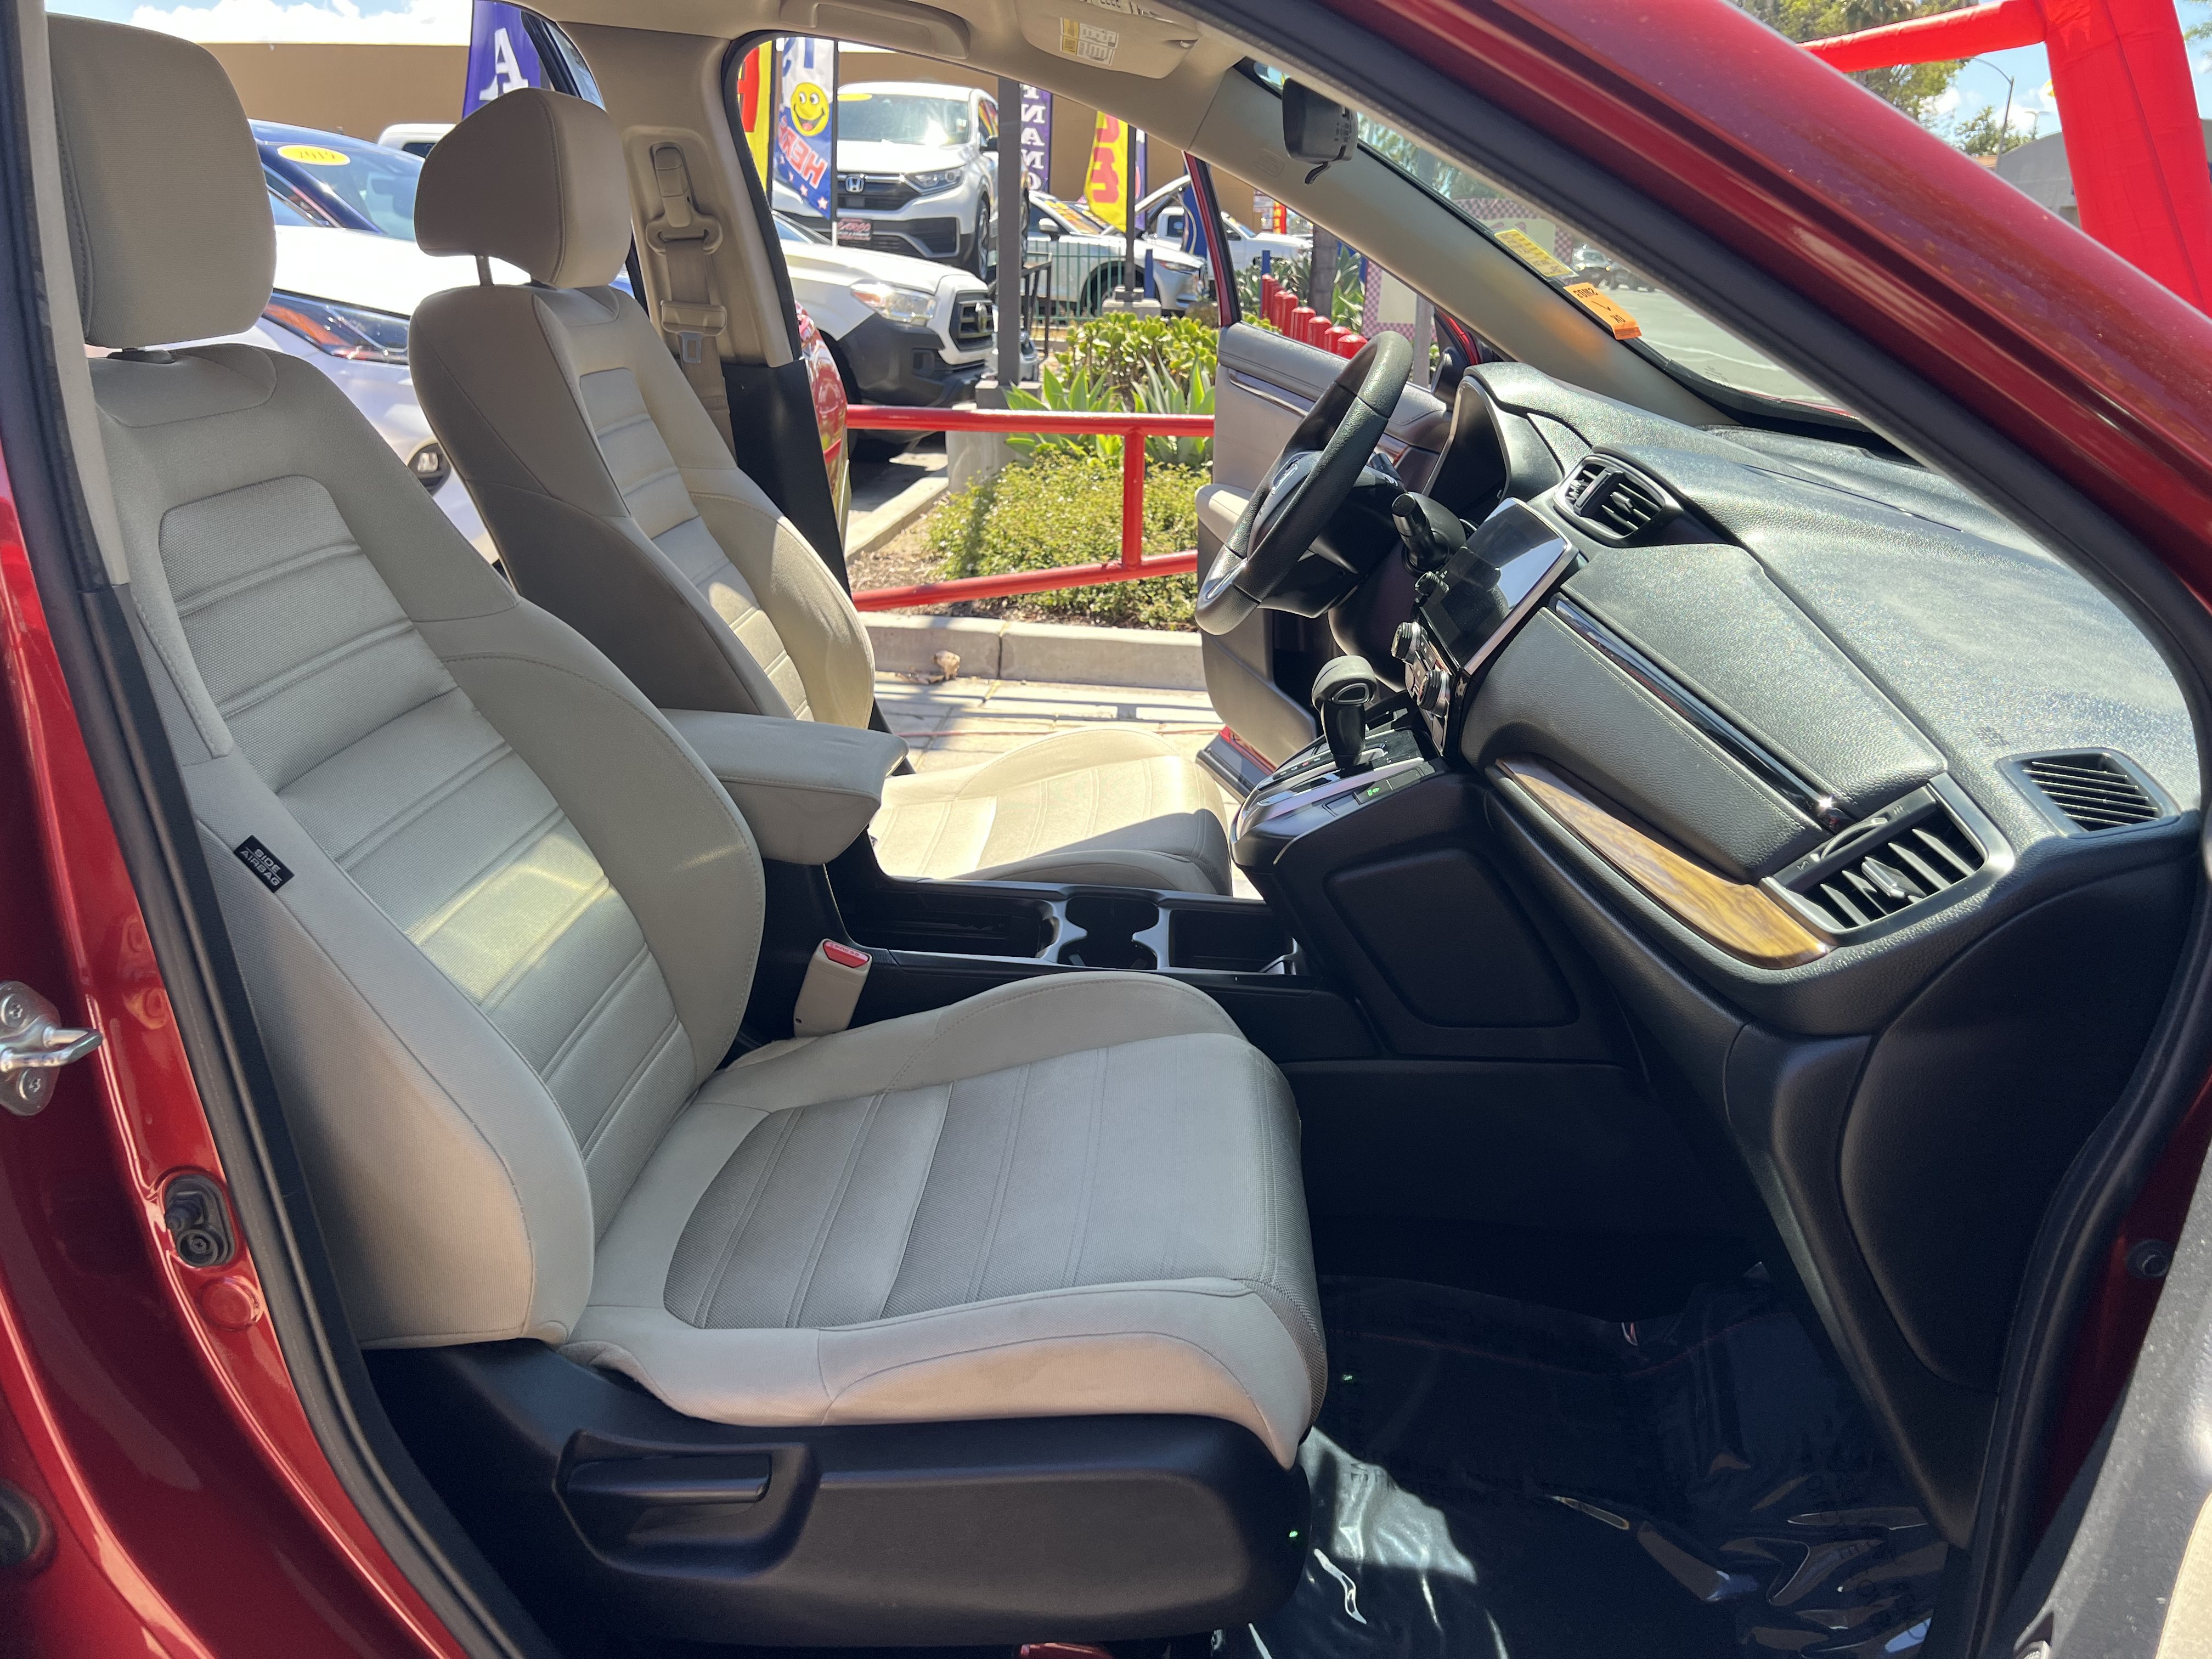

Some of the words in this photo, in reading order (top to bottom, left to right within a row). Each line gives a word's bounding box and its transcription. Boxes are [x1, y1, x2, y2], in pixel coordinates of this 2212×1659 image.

[240, 850, 280, 886] AIRBAG
[254, 849, 281, 873] SIDE
[834, 945, 860, 957] PRESS
